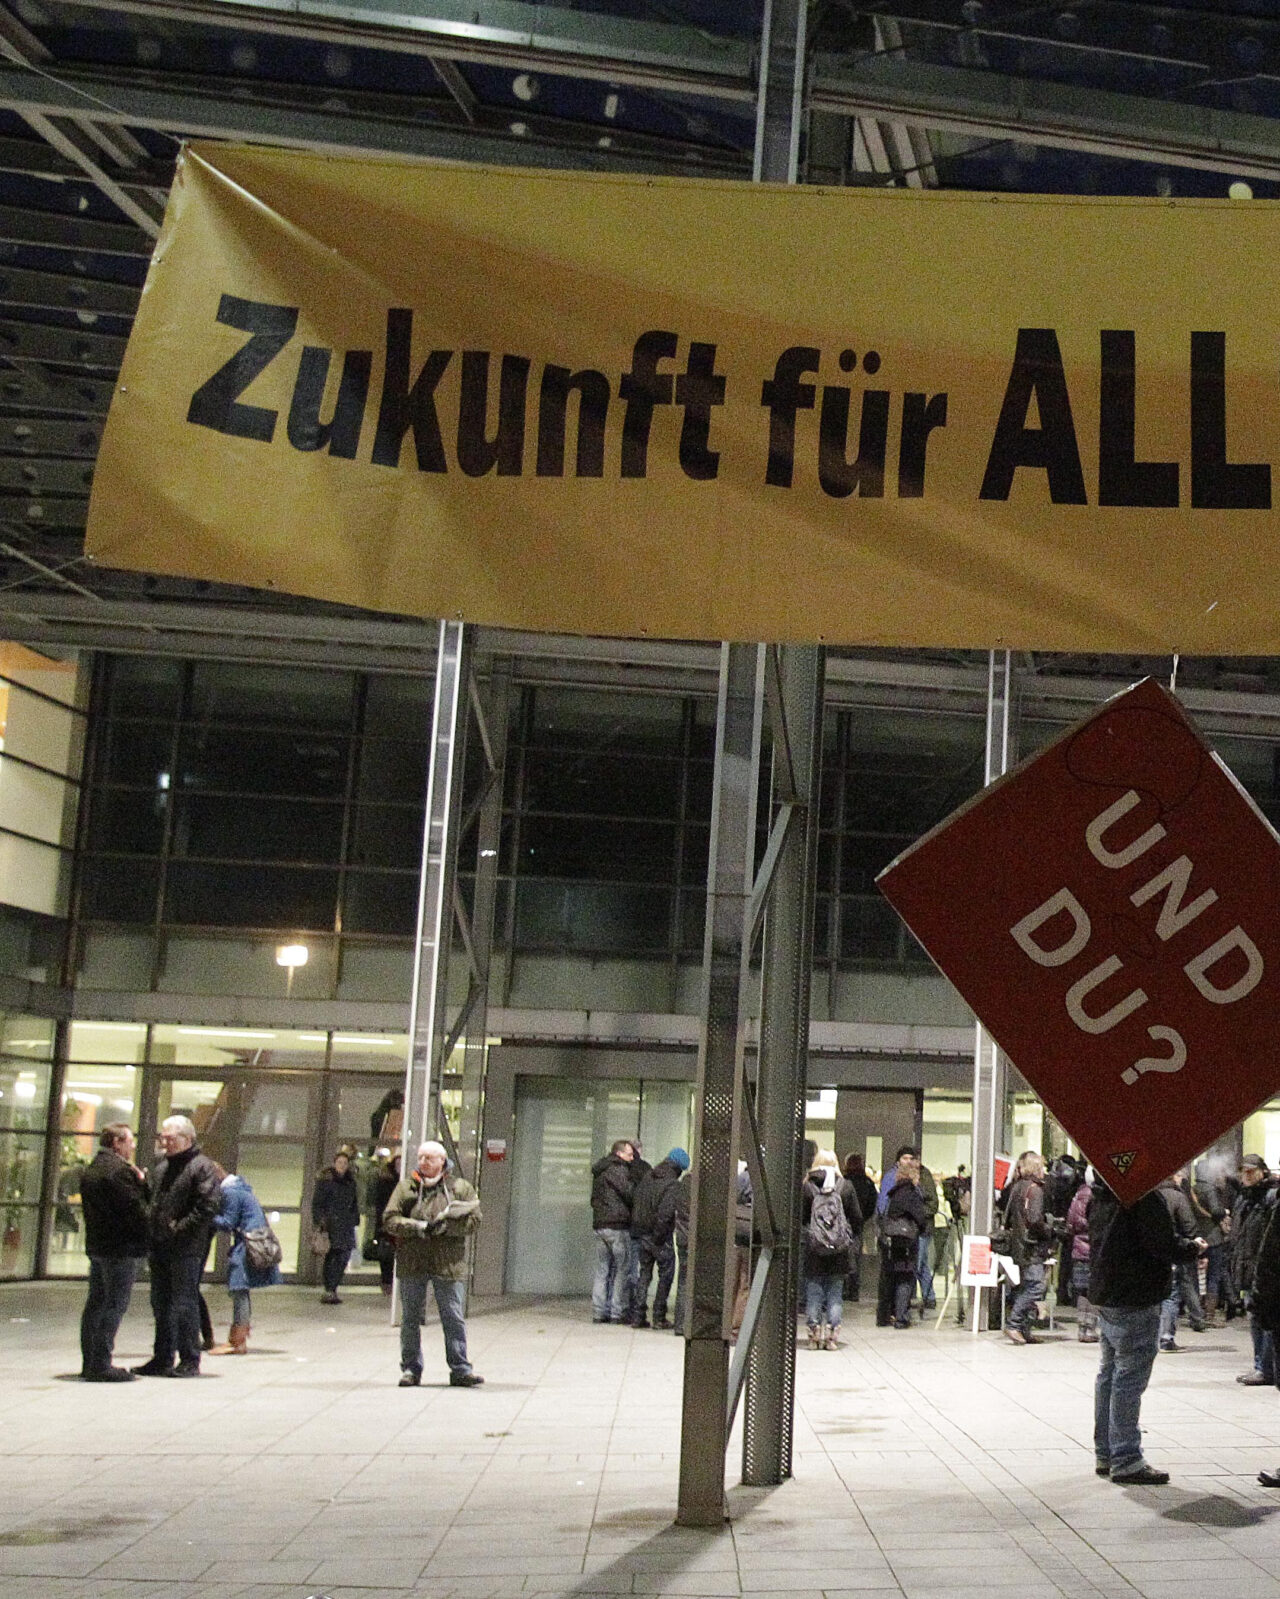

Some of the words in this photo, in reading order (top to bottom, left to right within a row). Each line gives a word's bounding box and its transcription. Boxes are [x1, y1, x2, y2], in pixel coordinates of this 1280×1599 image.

[187, 294, 727, 482] Zukunft
[760, 345, 948, 500] für
[1008, 886, 1188, 1087] DU?
[1085, 788, 1265, 1006] UND
